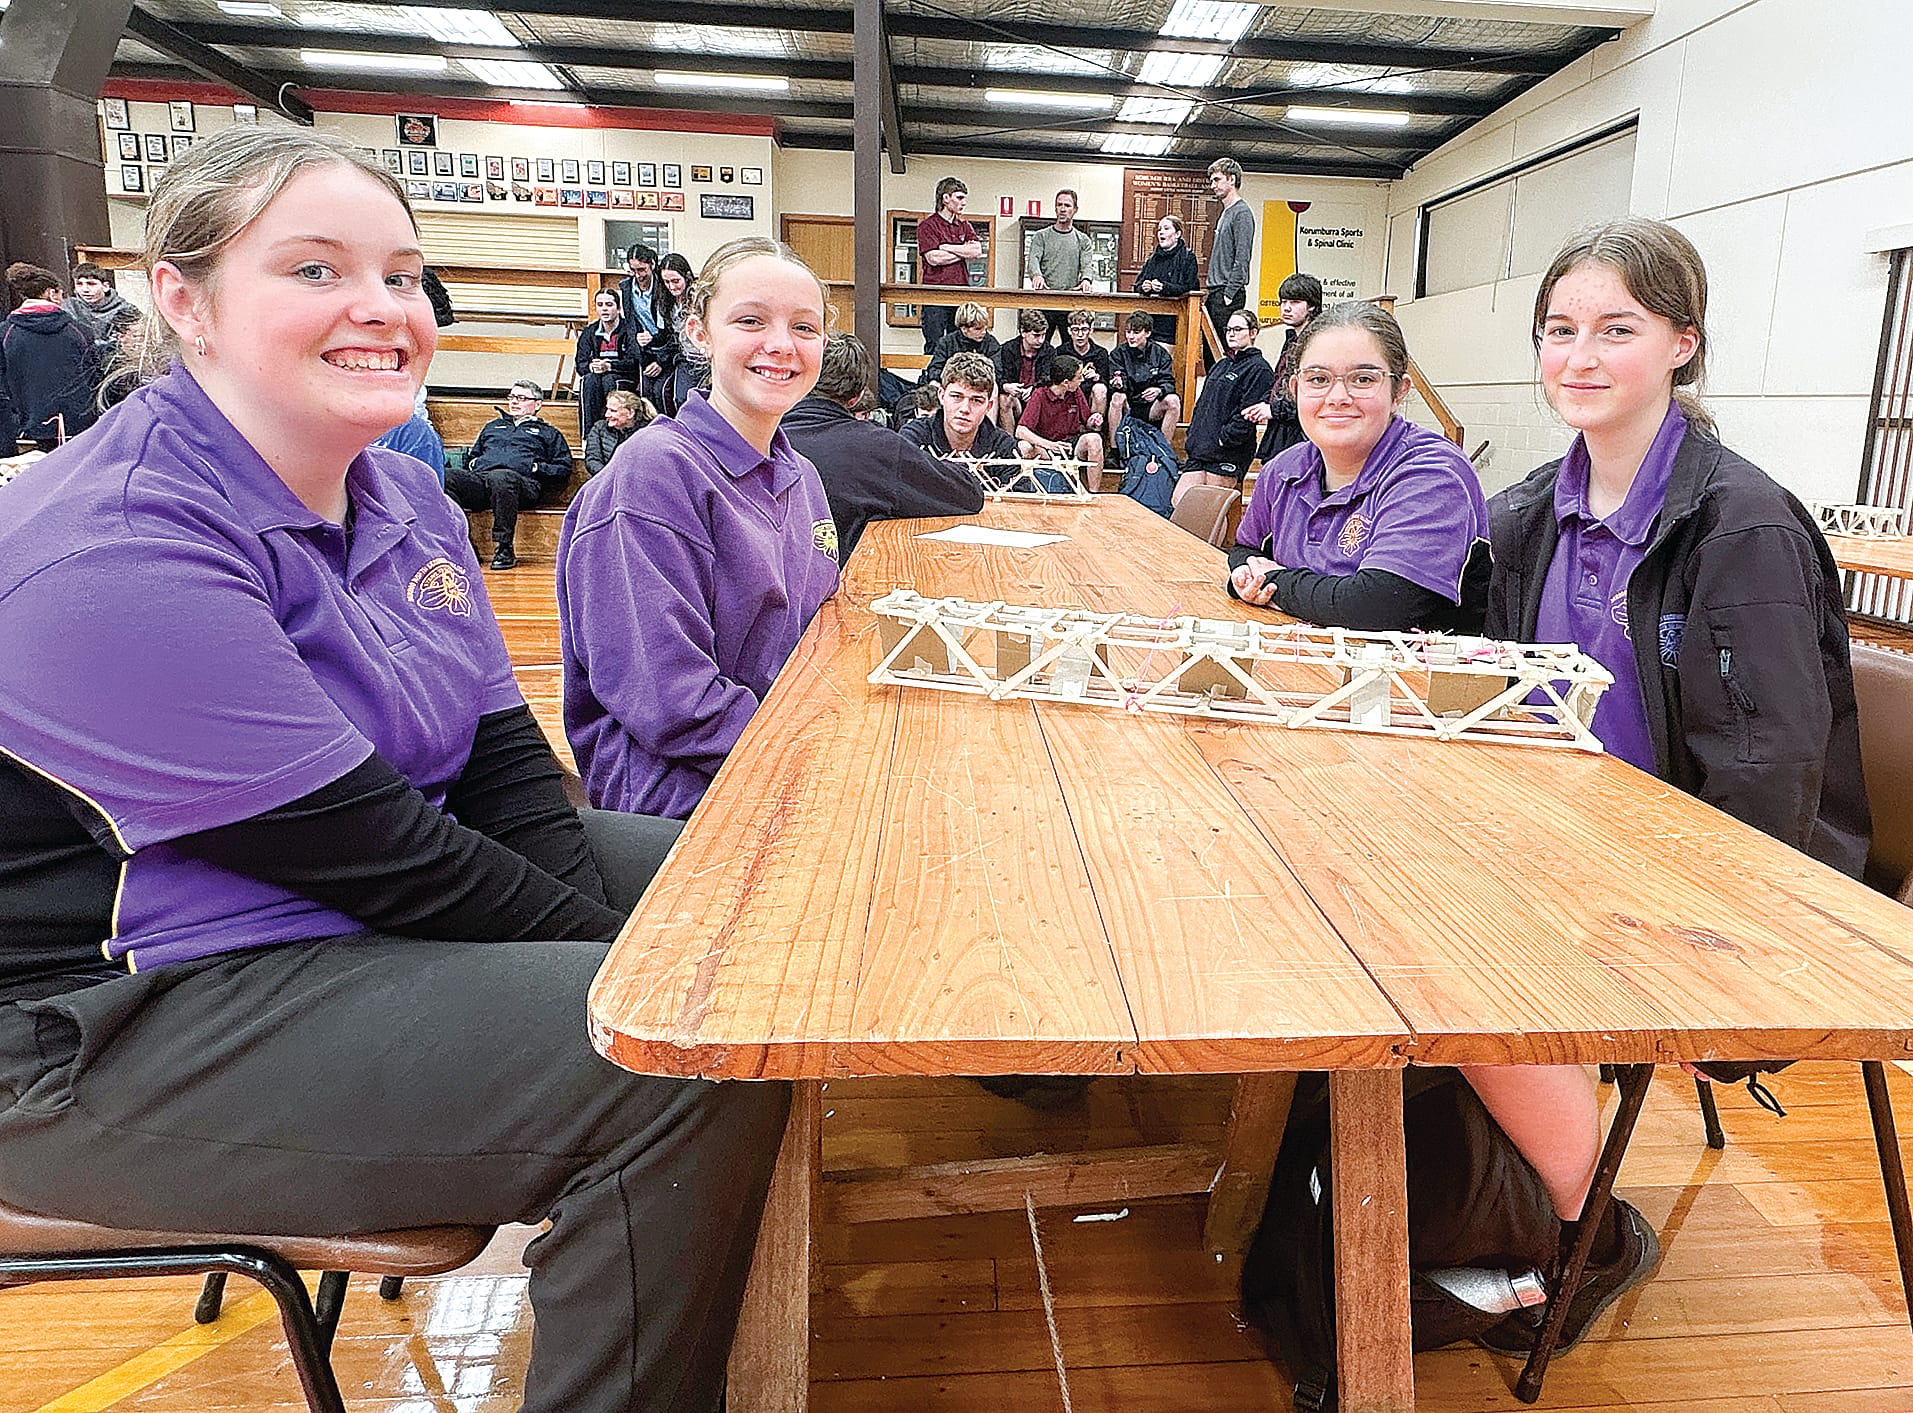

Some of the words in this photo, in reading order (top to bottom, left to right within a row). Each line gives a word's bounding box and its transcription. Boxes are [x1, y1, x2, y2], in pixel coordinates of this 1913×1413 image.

[1300, 226, 1339, 236] Korumburra
[1341, 227, 1363, 238] Sports
[1307, 239, 1312, 247] &
[1314, 239, 1335, 249] Spinal
[1336, 239, 1355, 249] Clinic
[1330, 279, 1356, 287] effective
[1338, 290, 1345, 298] of
